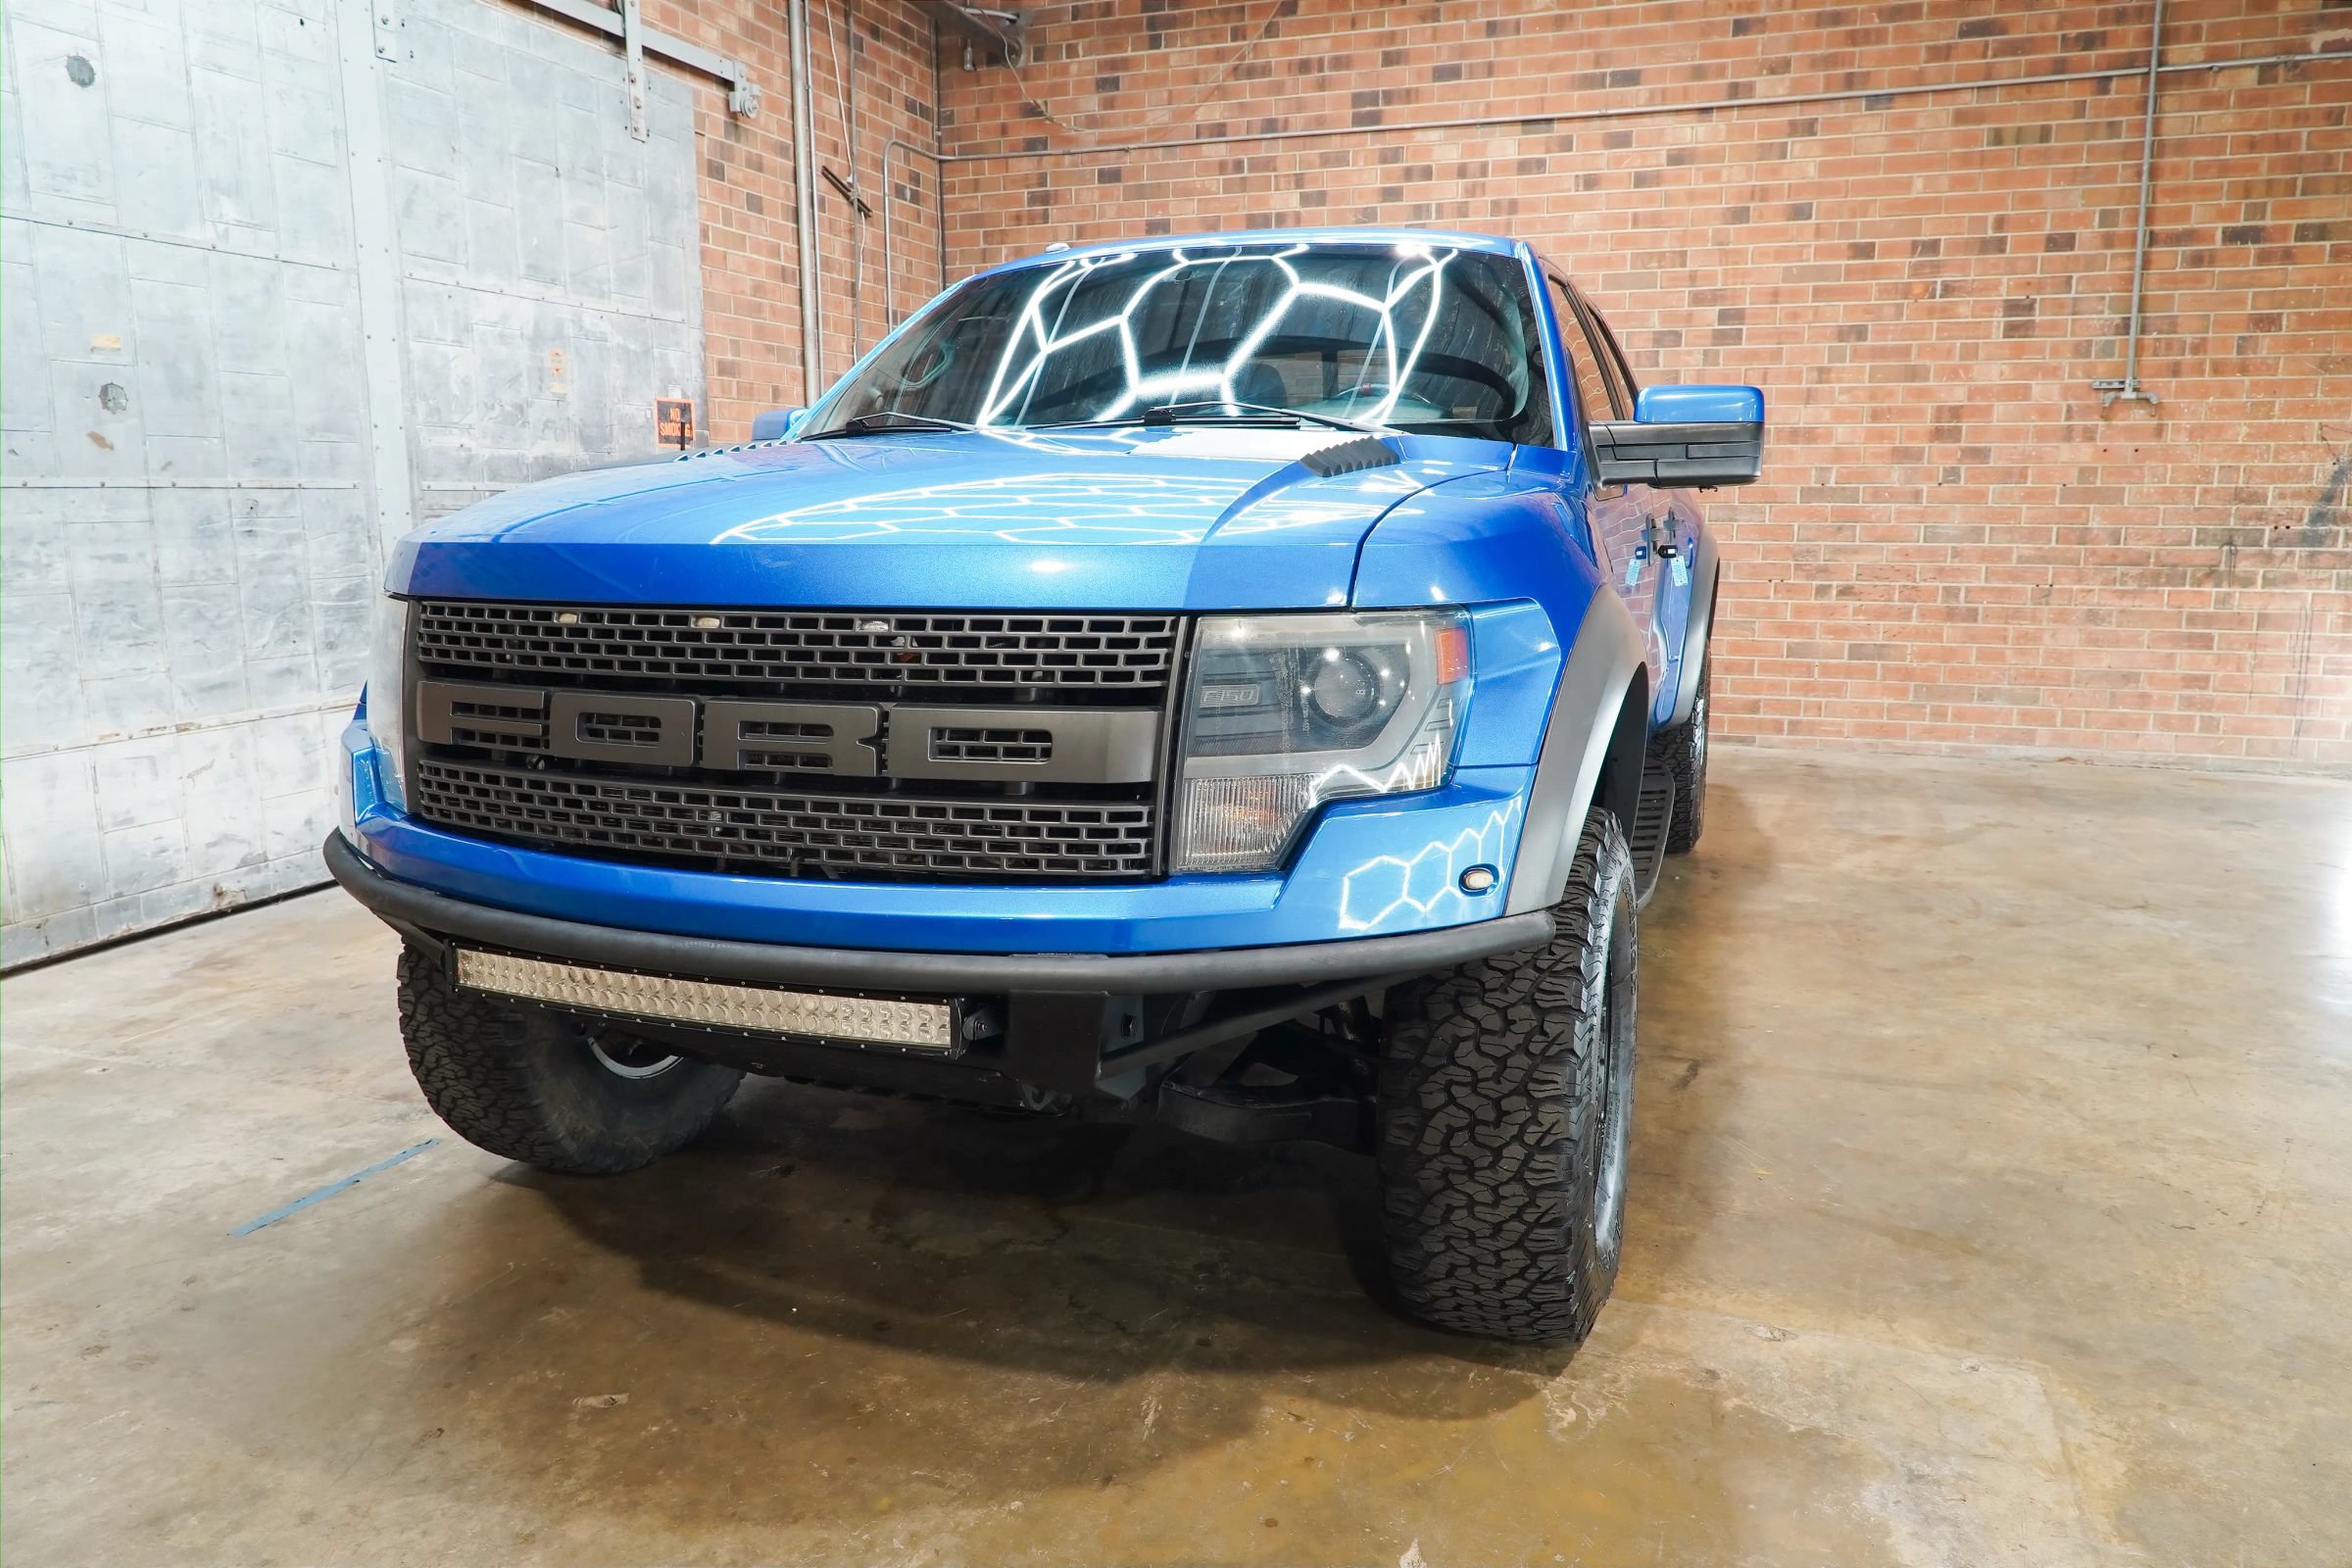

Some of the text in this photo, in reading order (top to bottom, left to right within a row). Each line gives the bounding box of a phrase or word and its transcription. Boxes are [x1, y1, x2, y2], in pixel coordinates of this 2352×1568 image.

[669, 407, 681, 422] NO
[660, 421, 691, 437] SMOKG
[416, 680, 1158, 784] FORD
